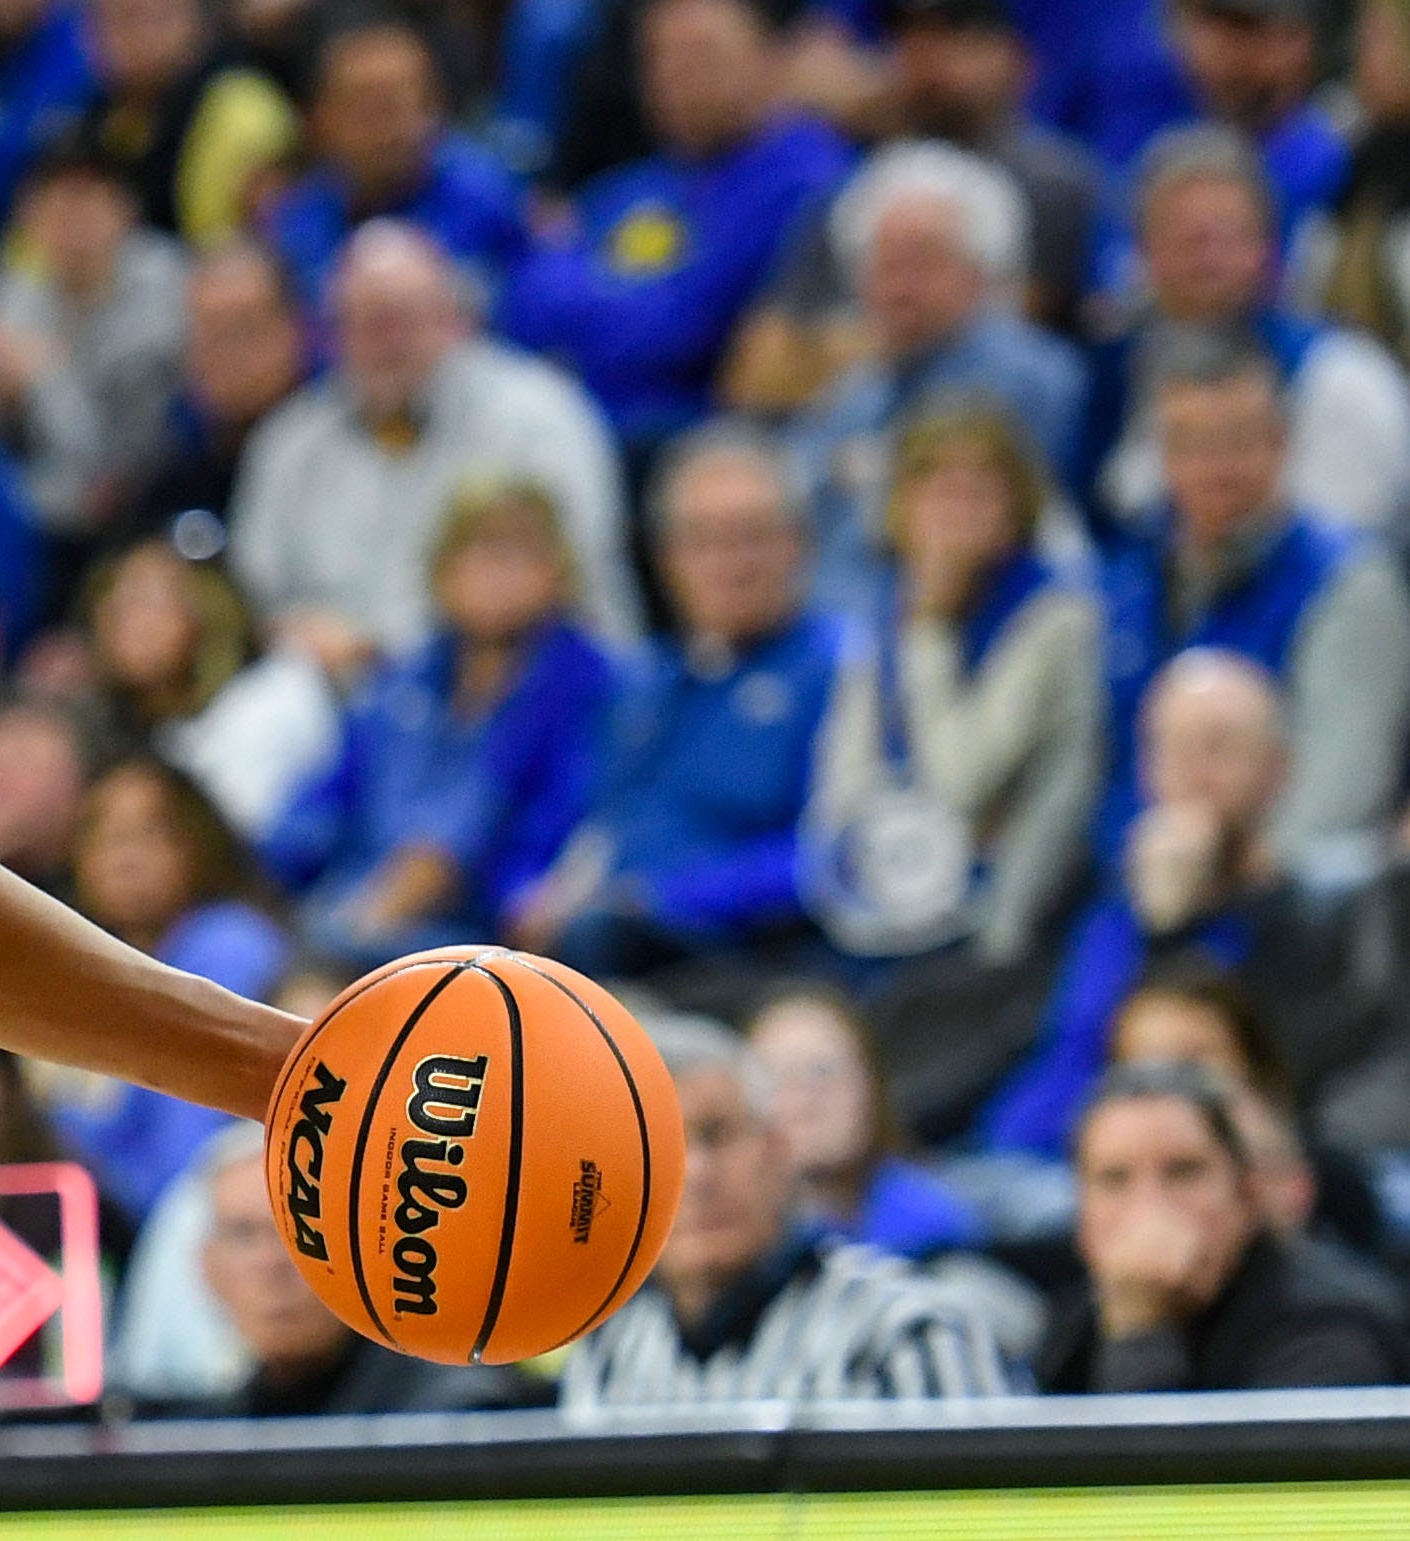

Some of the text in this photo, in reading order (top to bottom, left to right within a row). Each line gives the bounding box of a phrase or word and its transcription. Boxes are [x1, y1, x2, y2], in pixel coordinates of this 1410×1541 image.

[287, 1061, 348, 1263] NCAA
[378, 1127, 397, 1255] INDOOR GAME BALL
[391, 1054, 491, 1317] Wilson
[574, 1160, 597, 1244] SUMMIT
